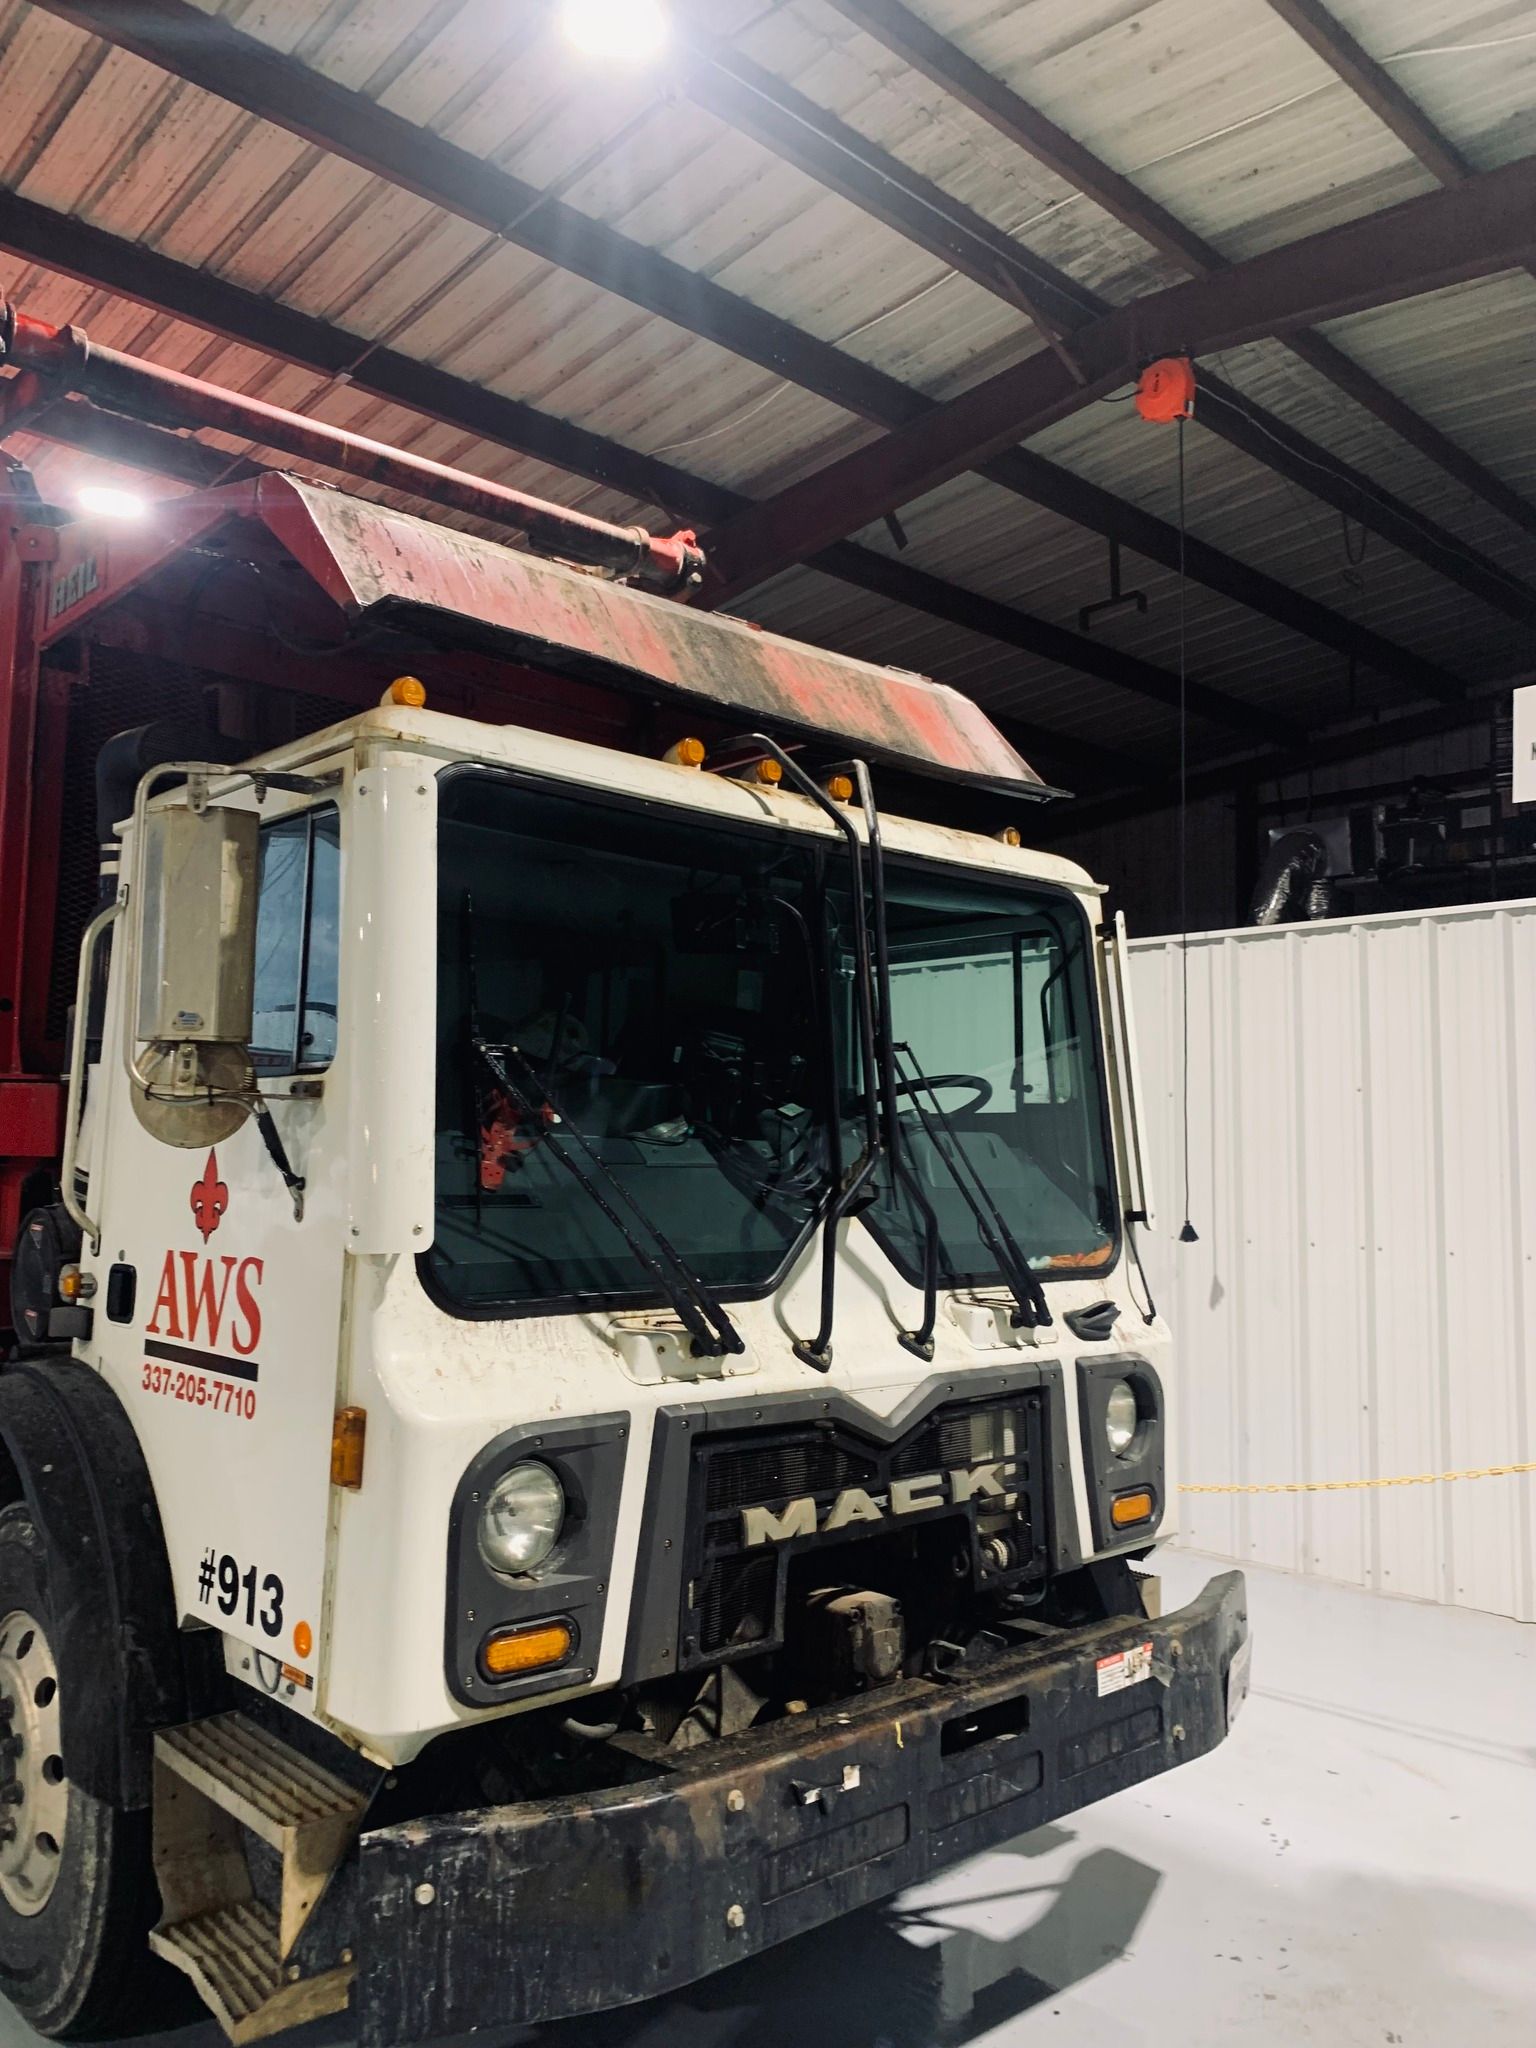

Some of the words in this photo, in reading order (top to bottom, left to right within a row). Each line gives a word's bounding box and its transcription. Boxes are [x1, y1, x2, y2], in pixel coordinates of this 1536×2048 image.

[145, 1250, 264, 1355] AWS
[142, 1363, 256, 1420] 337-205-7710
[739, 1462, 1006, 1549] MACK
[198, 1547, 284, 1637] #913
